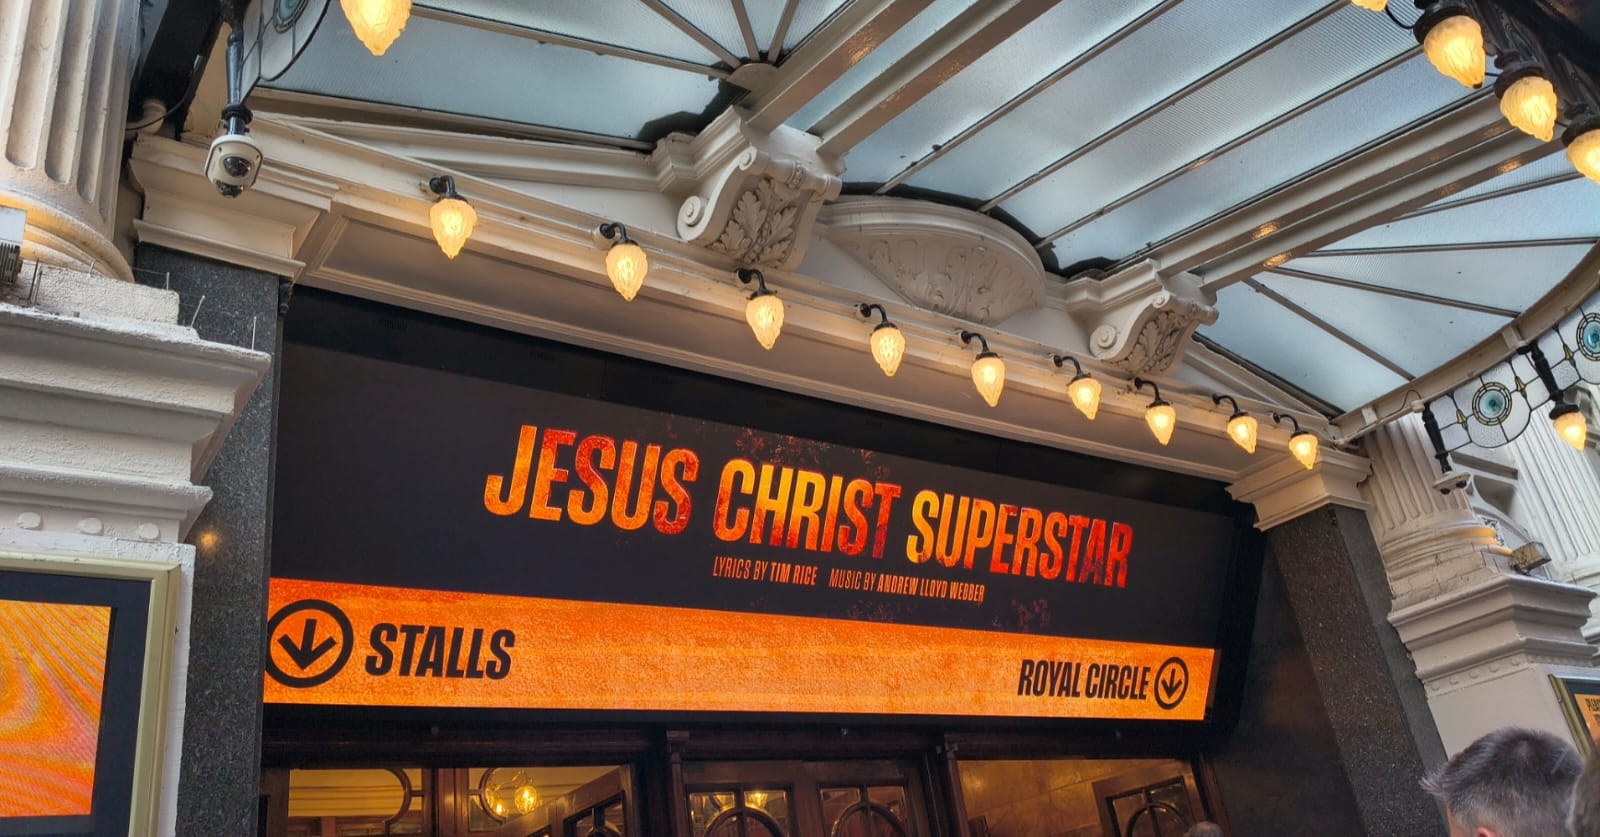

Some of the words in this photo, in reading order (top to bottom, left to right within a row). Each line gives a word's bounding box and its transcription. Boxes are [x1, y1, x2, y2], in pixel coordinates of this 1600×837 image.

[483, 424, 699, 535] JESUS
[712, 458, 902, 559] CHRIST
[906, 489, 1134, 589] SUPERSTAR
[712, 556, 750, 580] LYRICS
[753, 561, 769, 581] BY
[769, 562, 790, 584] TIM
[792, 565, 818, 586] RICE
[828, 568, 861, 588] MUSIC
[863, 572, 877, 591] BY
[877, 574, 918, 596] ANDREW
[919, 579, 948, 597] LLOYD
[949, 582, 986, 602] WEBBER
[364, 622, 516, 680] STALLS
[1017, 659, 1081, 697] ROYAL
[1085, 663, 1151, 700] CIRCLE
